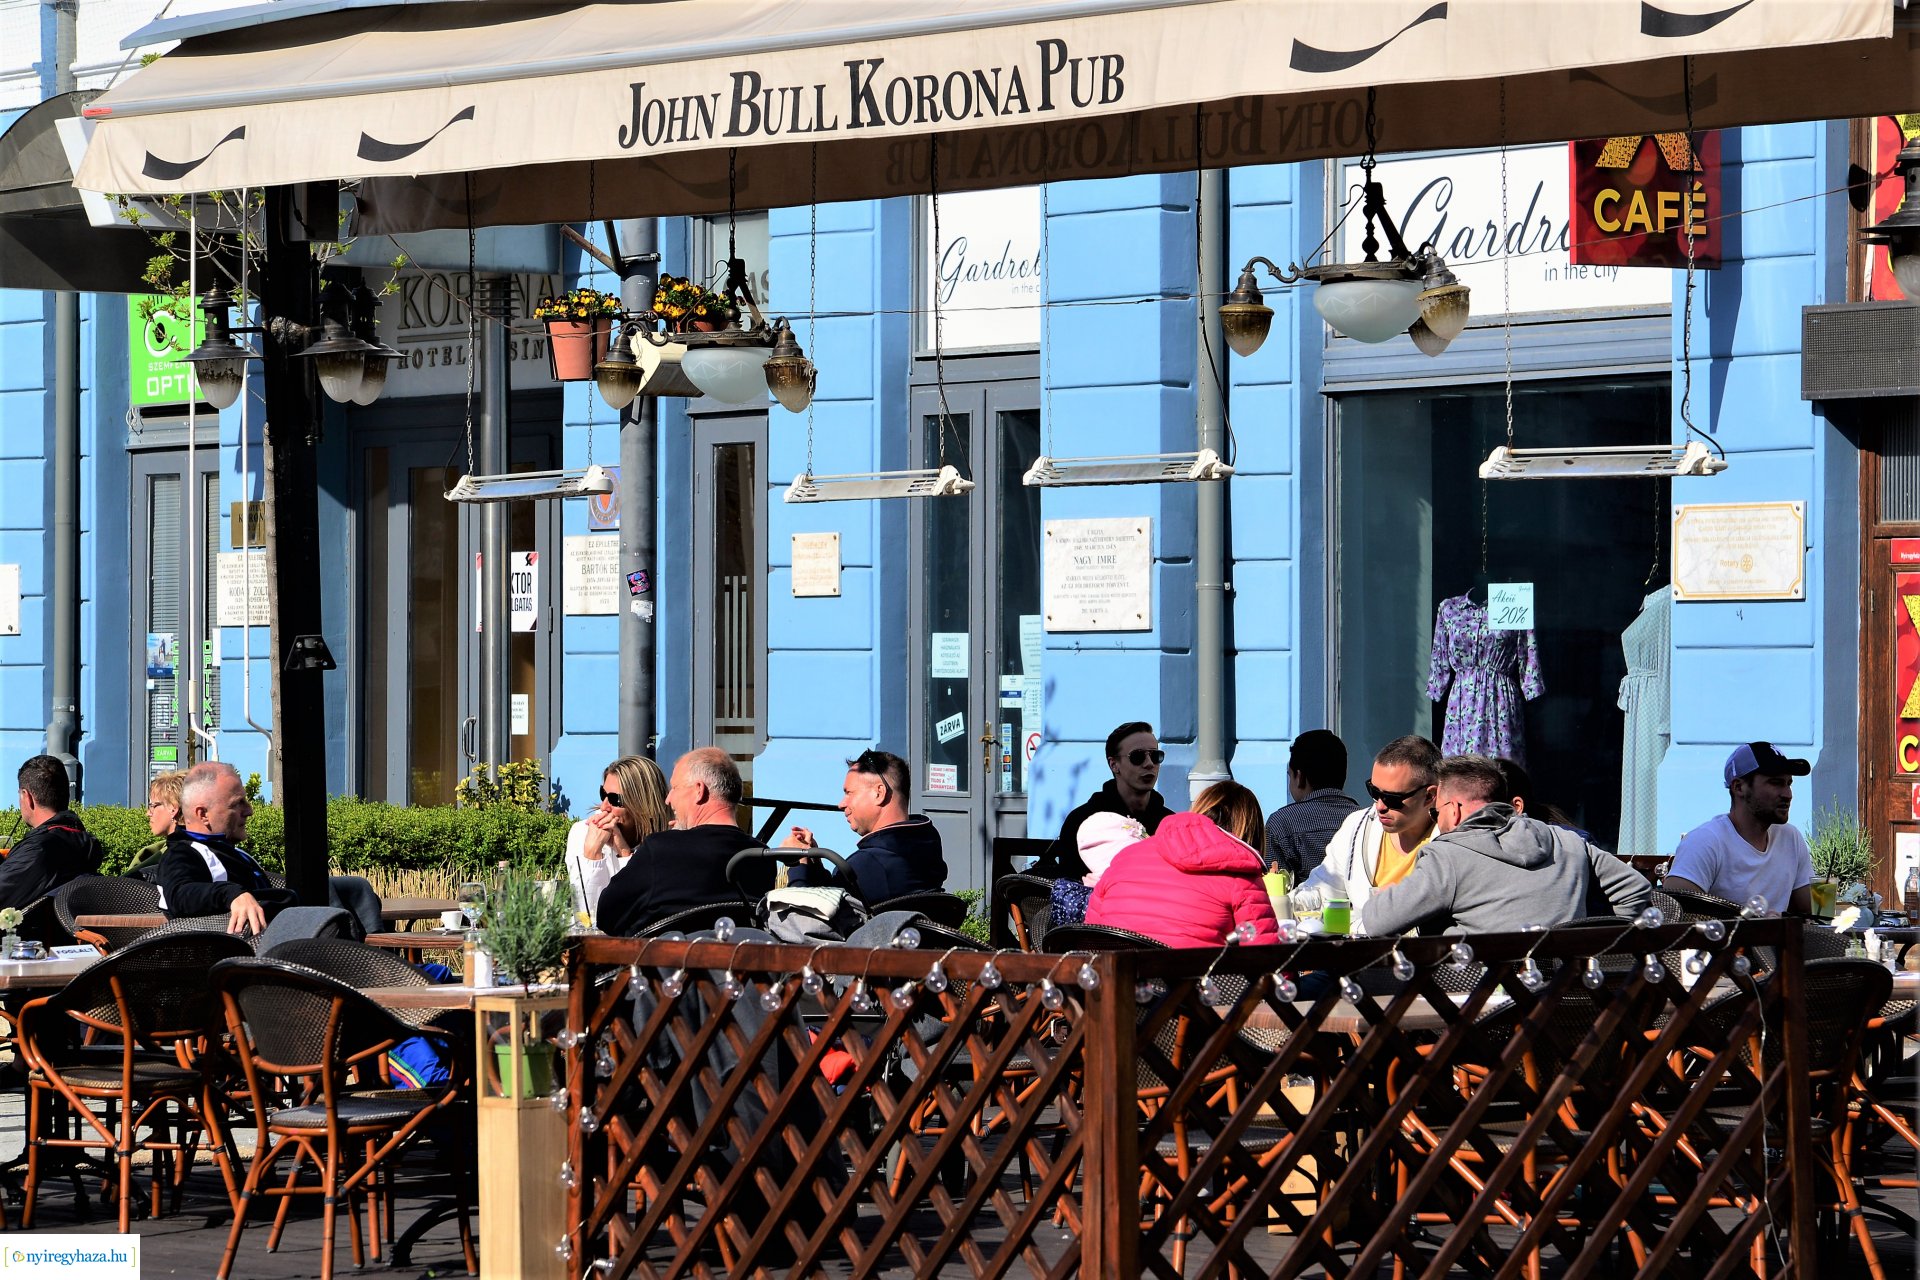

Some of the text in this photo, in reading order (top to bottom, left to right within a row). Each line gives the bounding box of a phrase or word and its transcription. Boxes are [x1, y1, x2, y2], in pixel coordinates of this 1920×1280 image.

[618, 38, 1125, 149] JOHN BULL KORONA PUB
[1593, 181, 1707, 235] CAFÉ
[1545, 262, 1558, 281] in
[1564, 262, 1588, 280] the
[1012, 283, 1019, 294] in
[1021, 283, 1033, 293] the
[397, 271, 555, 330] KORNA
[397, 345, 467, 370] HOTEL
[1073, 555, 1117, 565] NAGY IMRE
[1492, 606, 1529, 625] -20%
[203, 640, 213, 727] OPTIKA
[940, 717, 961, 736] ZÁRVA
